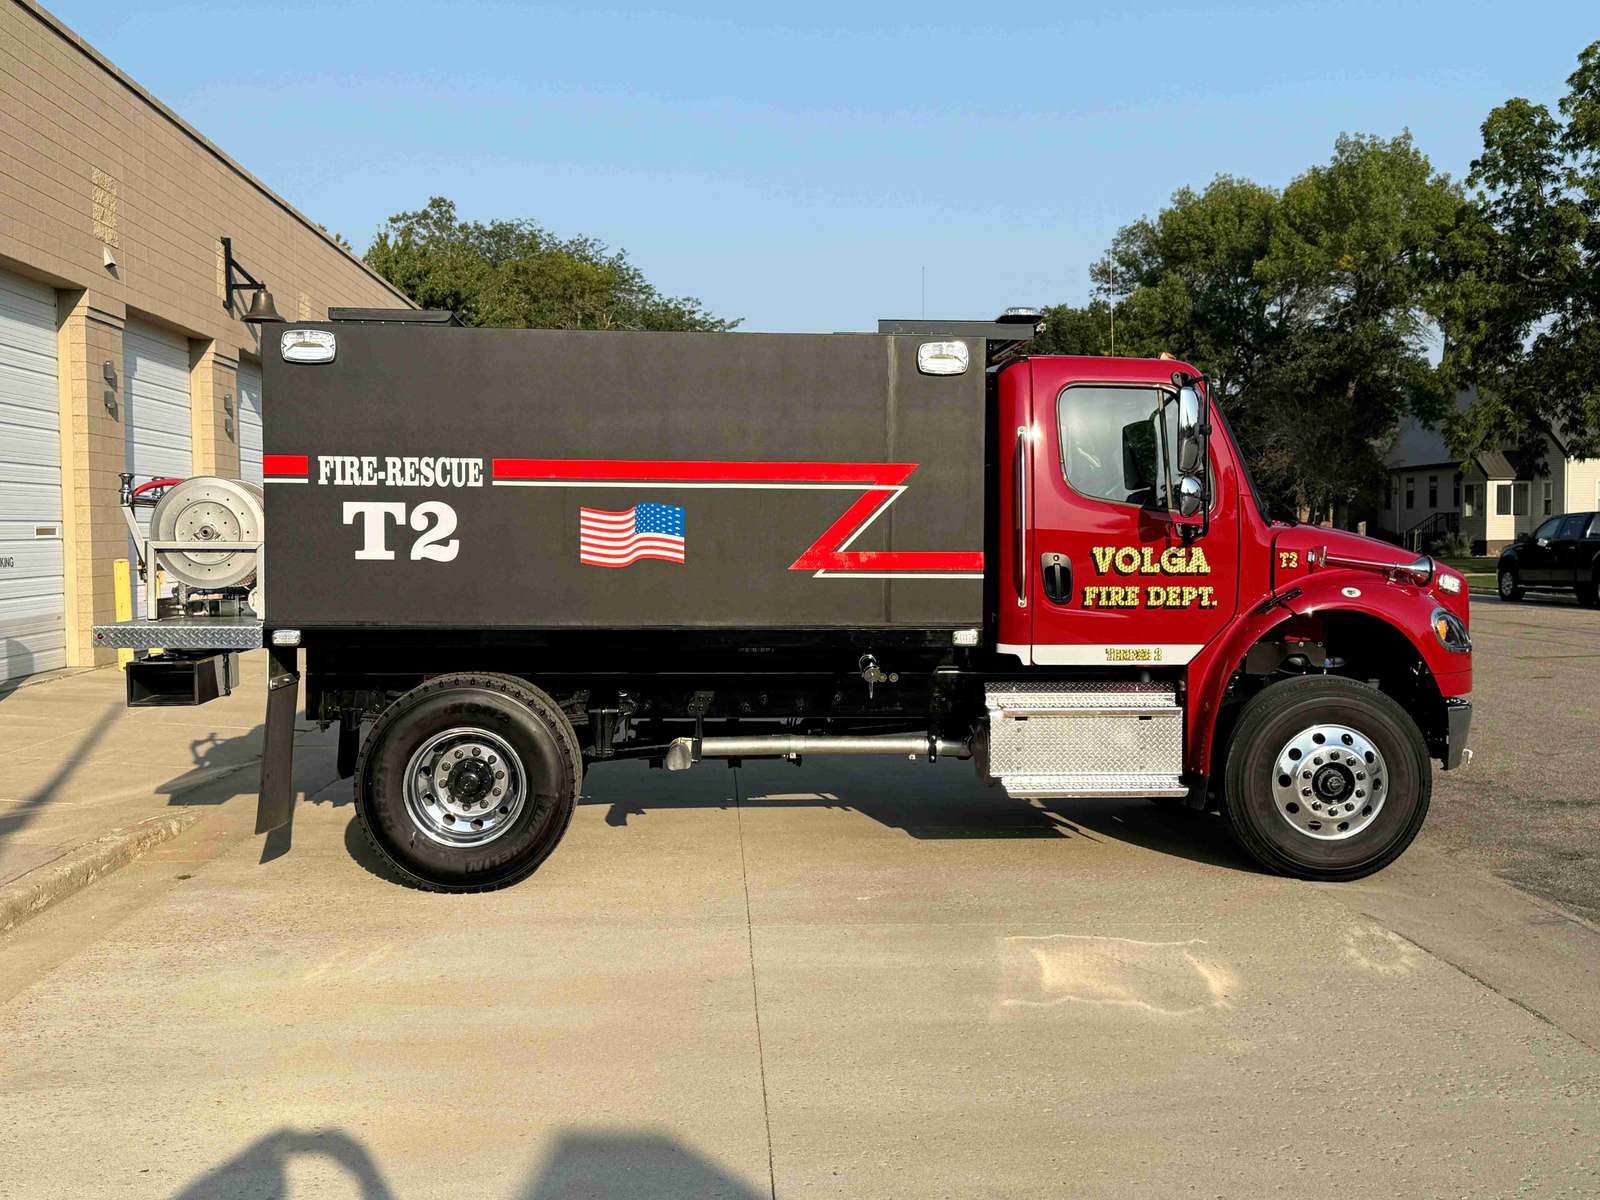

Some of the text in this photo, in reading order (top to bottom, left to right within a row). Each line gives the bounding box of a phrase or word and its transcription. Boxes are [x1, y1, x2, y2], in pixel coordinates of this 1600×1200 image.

[317, 455, 484, 488] FIRE-RESCUE
[342, 500, 460, 562] T2
[1090, 546, 1211, 575] VOLGA
[1279, 551, 1298, 568] T2
[1082, 586, 1217, 608] FIRE DEPT.
